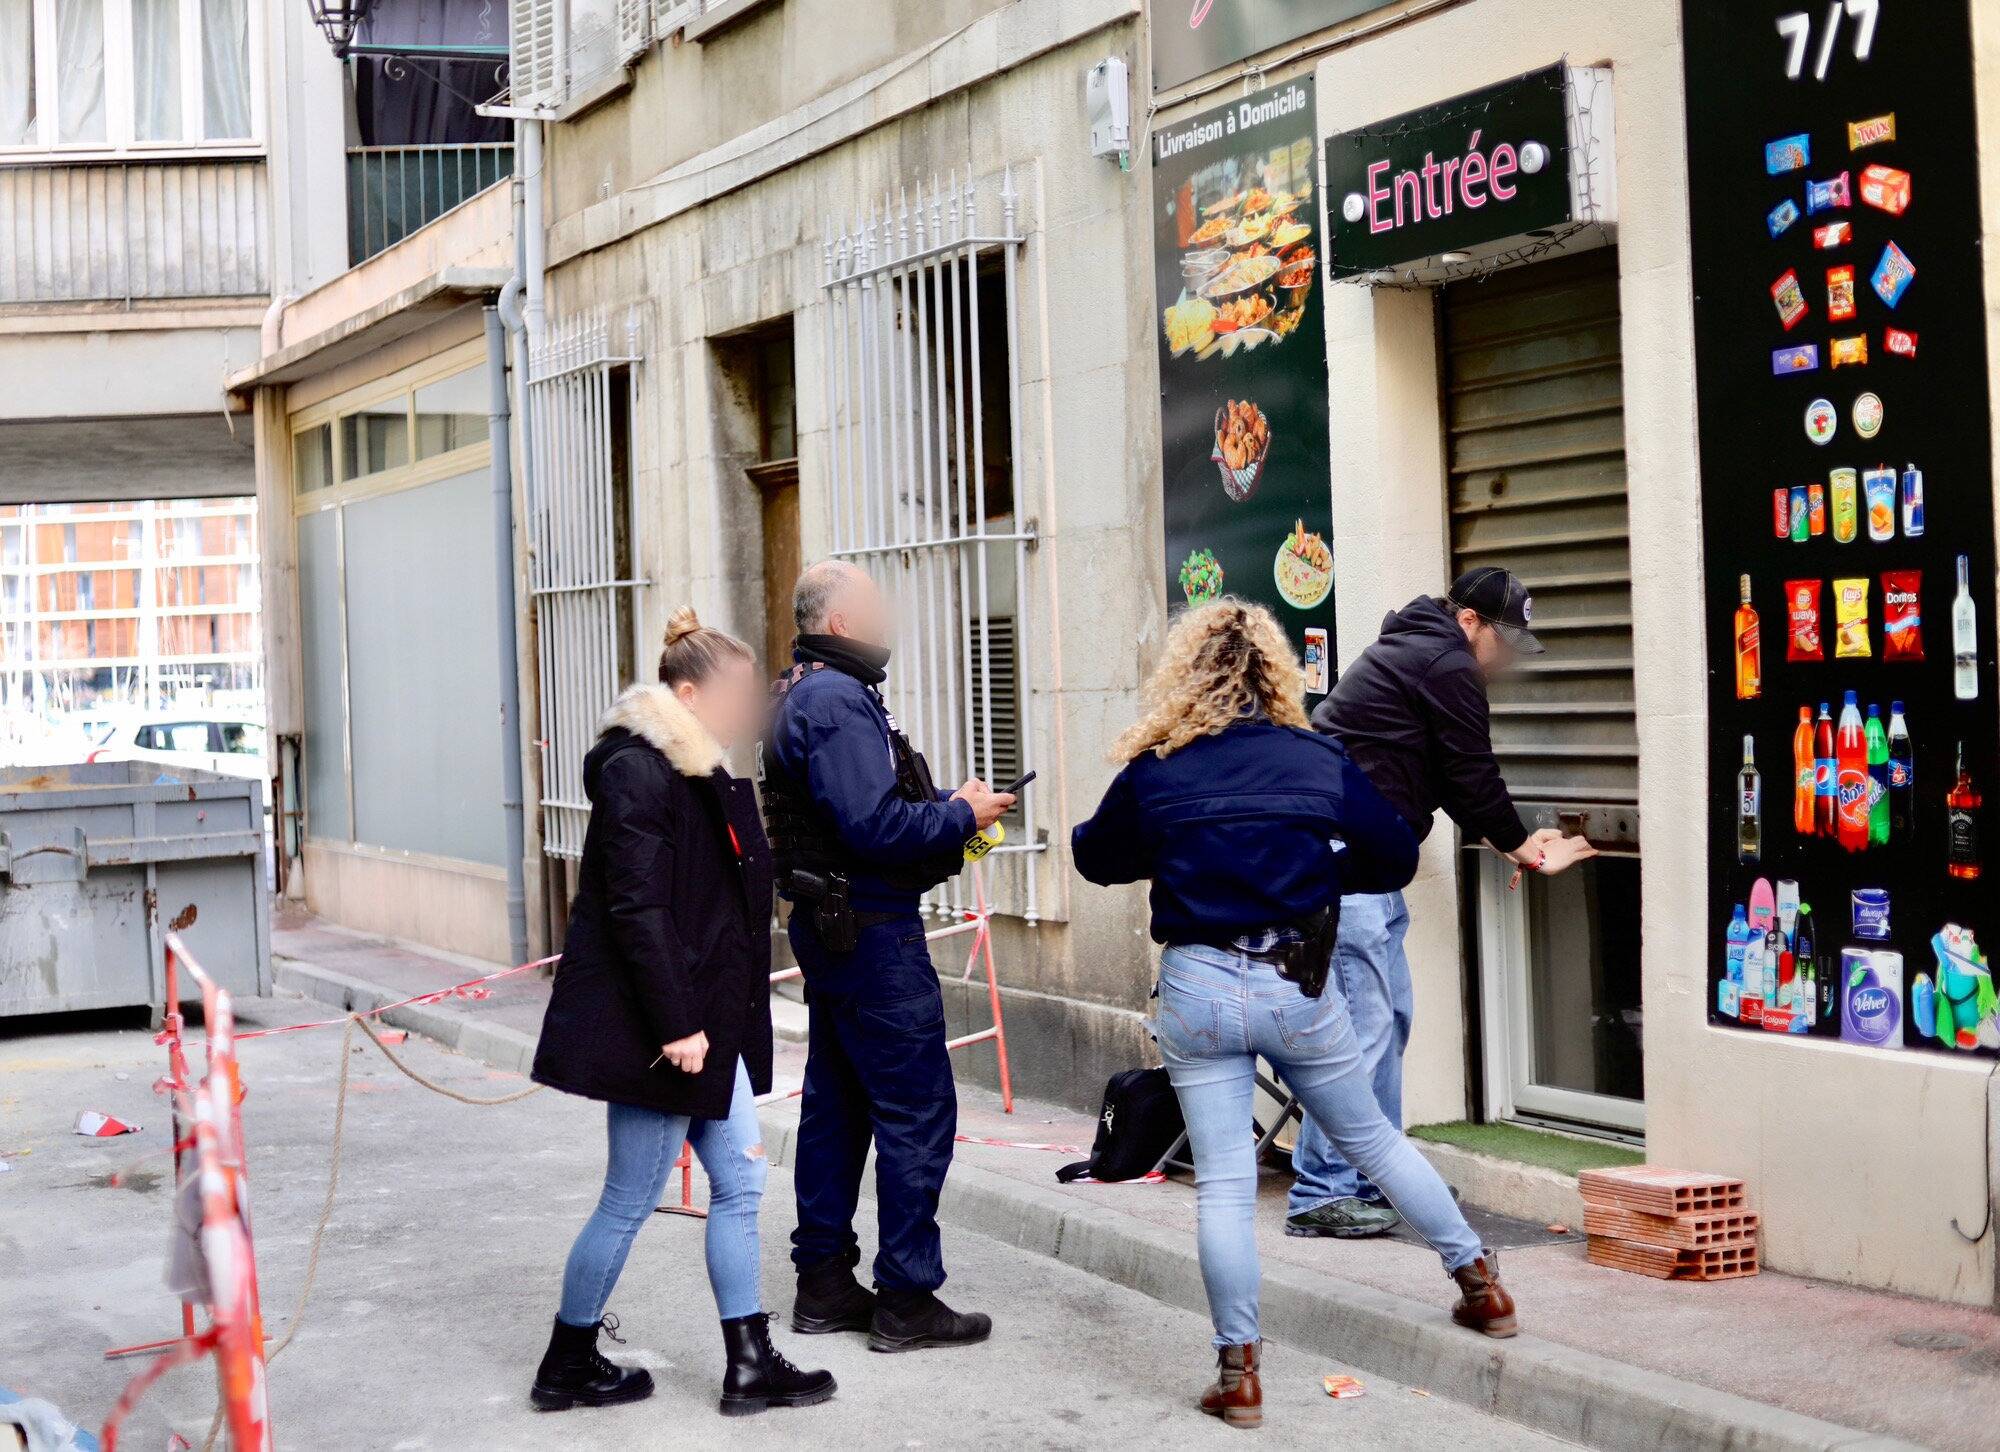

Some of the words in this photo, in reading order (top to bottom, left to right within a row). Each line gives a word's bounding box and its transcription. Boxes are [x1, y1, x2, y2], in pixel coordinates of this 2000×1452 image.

[1775, 0, 1879, 81] 7/7
[1159, 121, 1223, 159] Livraison
[1226, 110, 1236, 135] à
[1239, 85, 1306, 130] Domicile
[1367, 129, 1519, 234] Entrée
[1764, 1014, 1790, 1026] Colgate
[1854, 993, 1887, 1012] Velvet
